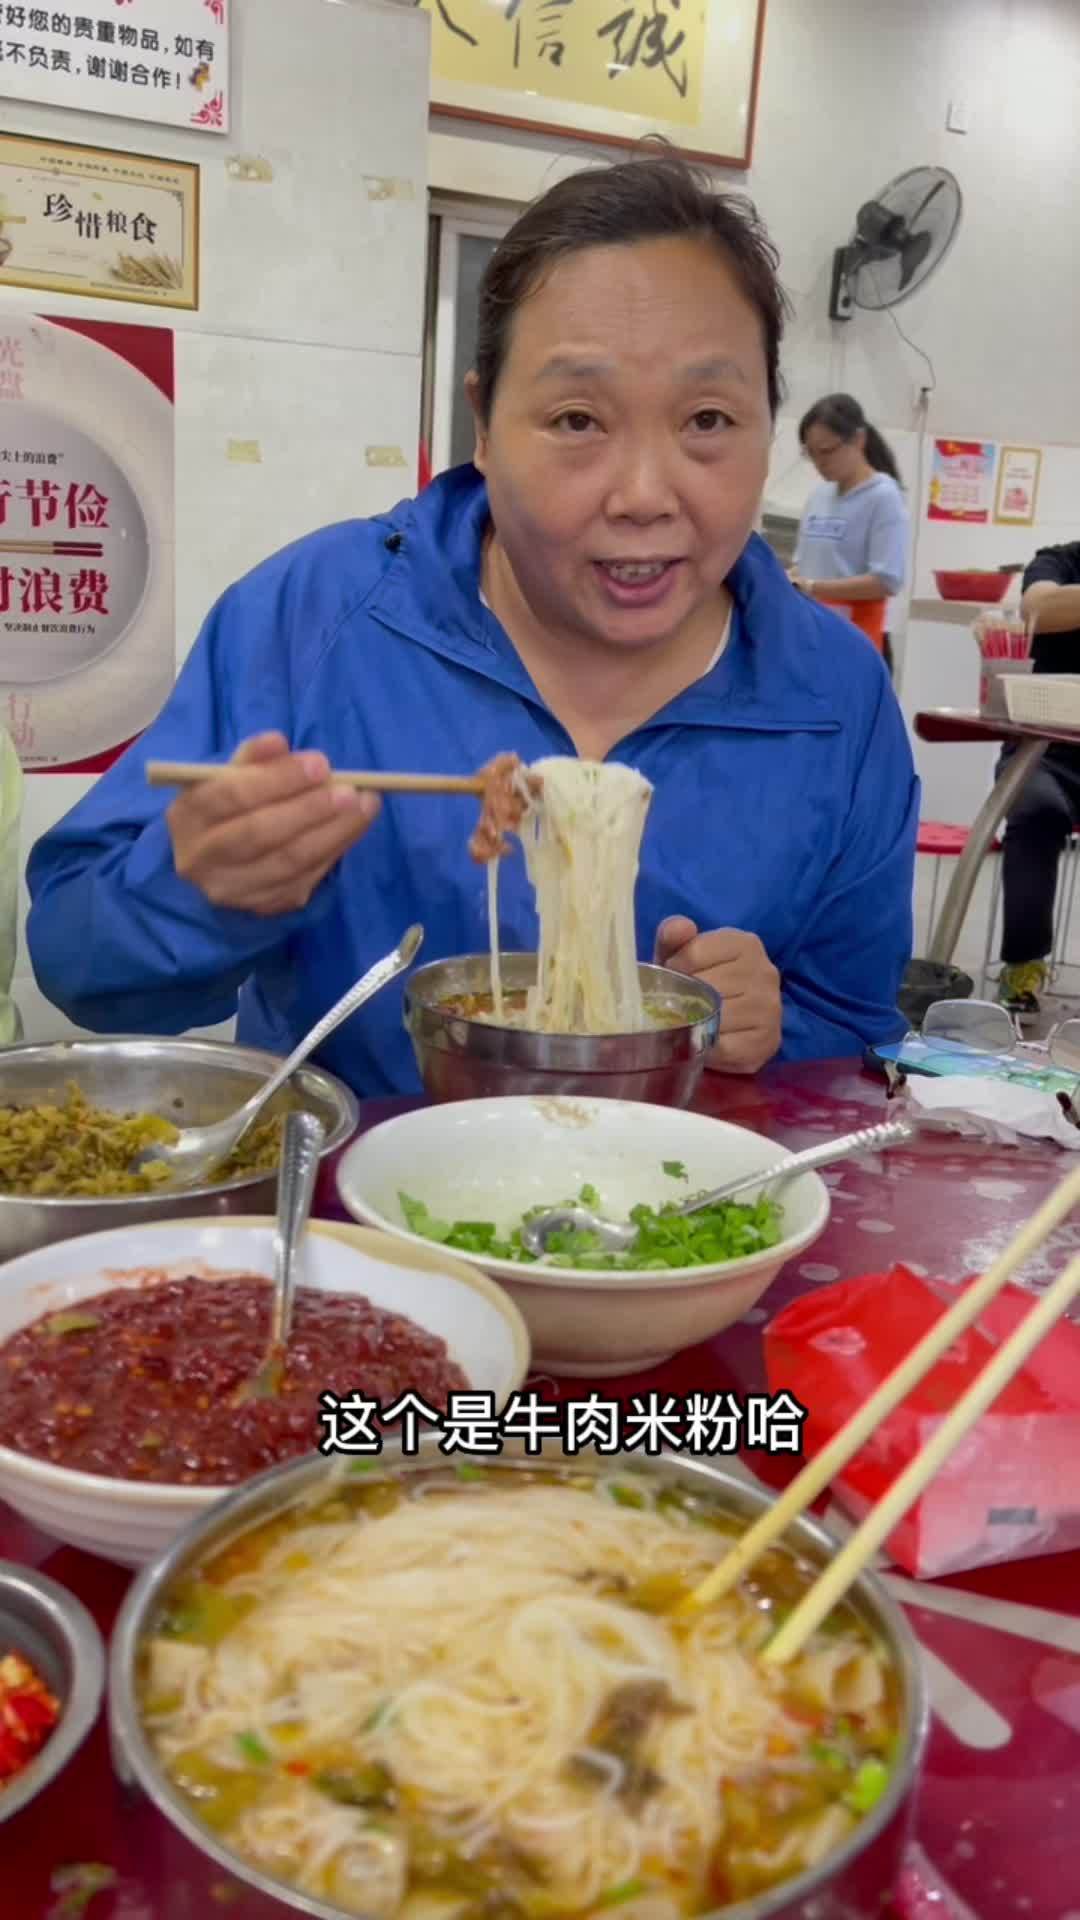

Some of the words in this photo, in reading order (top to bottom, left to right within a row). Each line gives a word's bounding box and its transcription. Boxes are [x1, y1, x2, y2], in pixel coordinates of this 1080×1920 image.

[0, 4, 215, 61] 好您的贵重物品，如有
[0, 40, 182, 90] 不负责，谢谢合作！
[43, 193, 158, 244] 珍惜粮食
